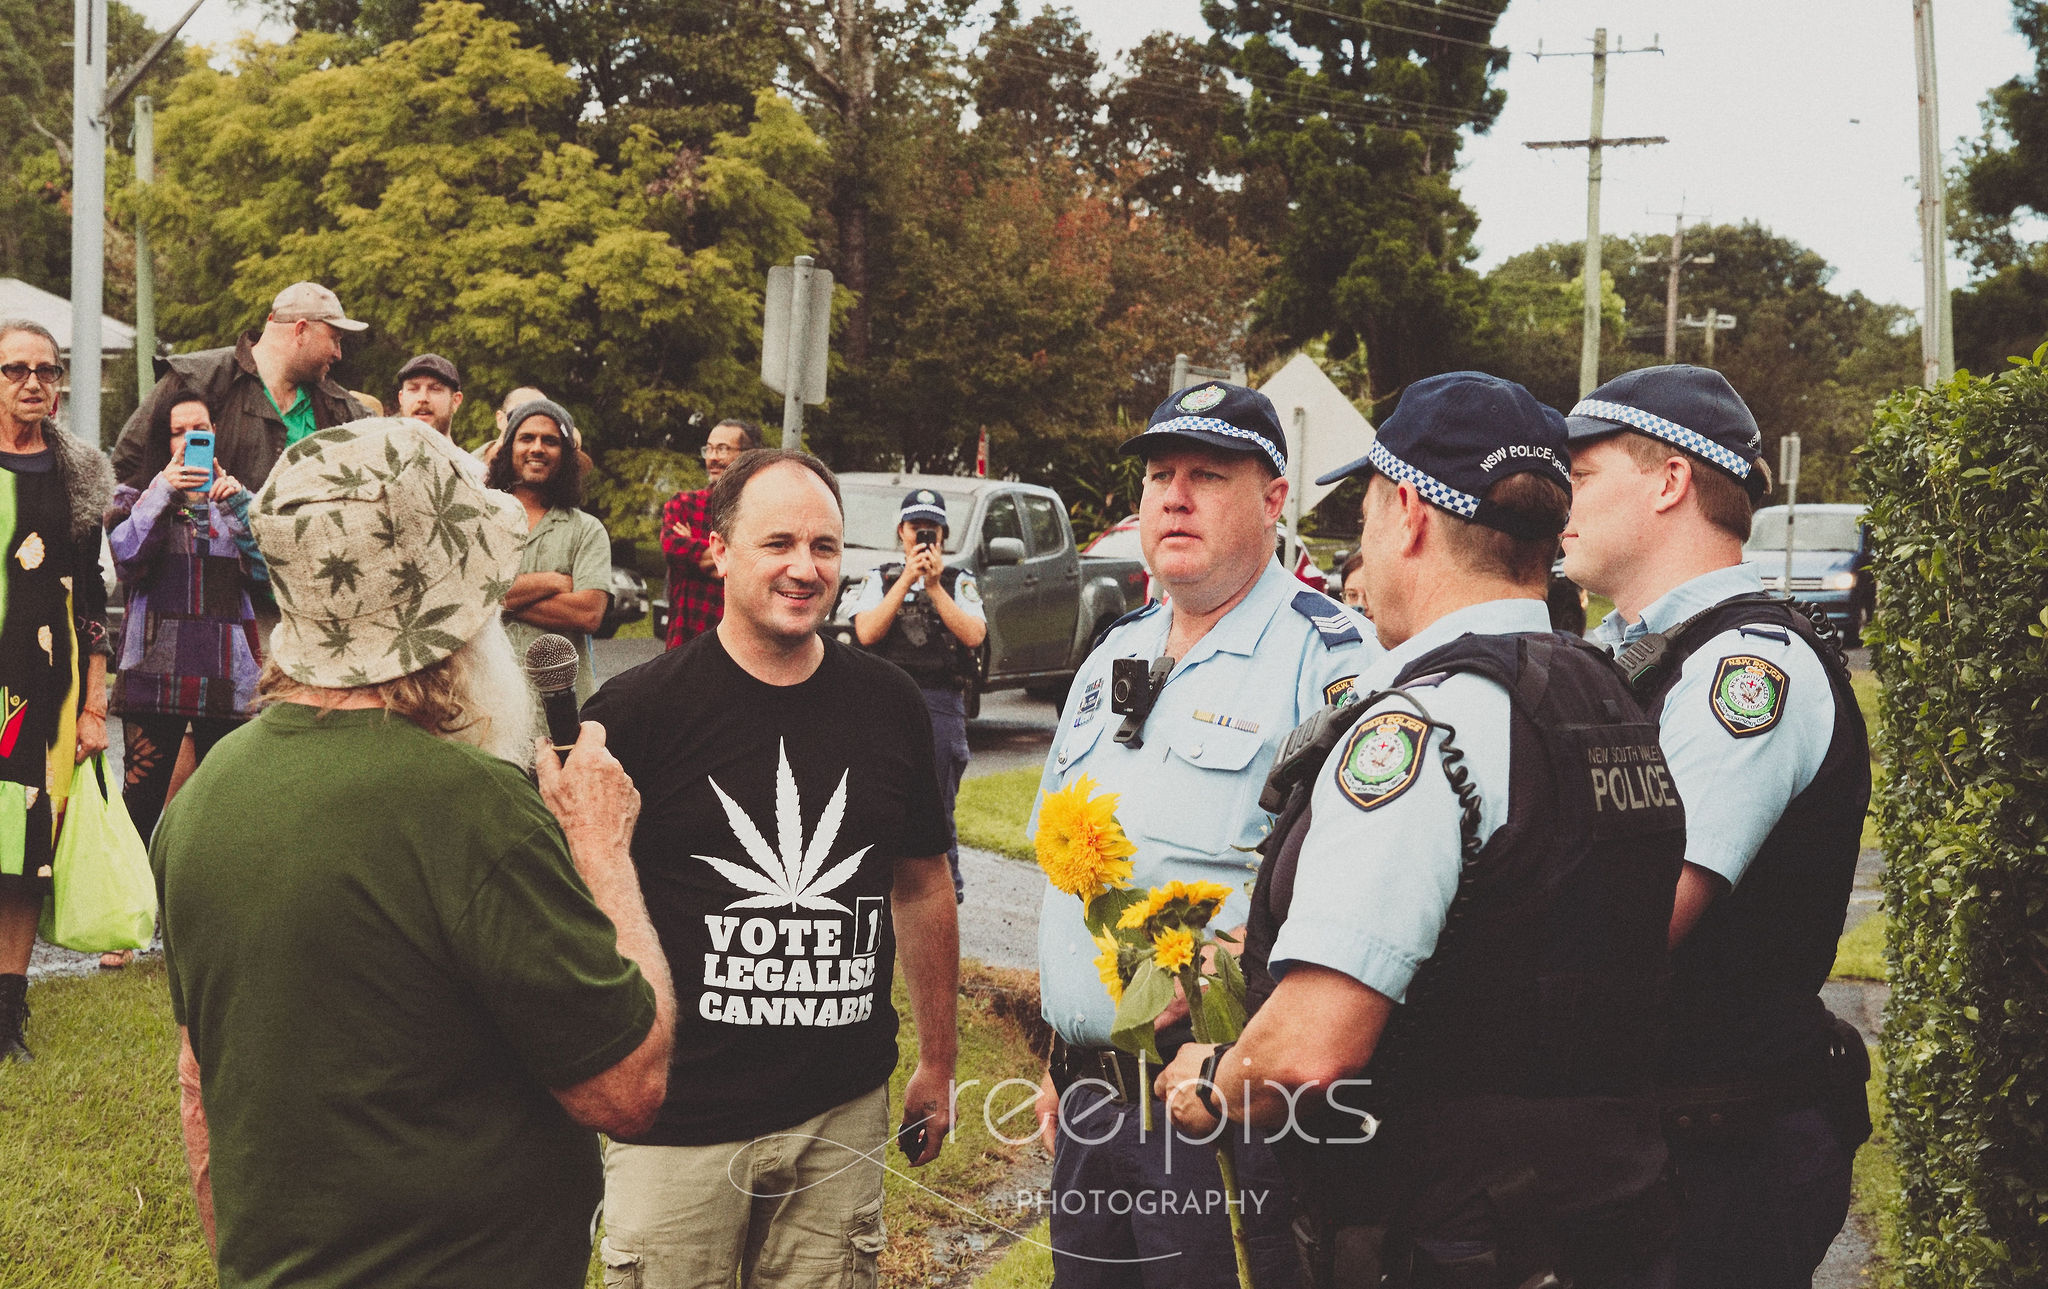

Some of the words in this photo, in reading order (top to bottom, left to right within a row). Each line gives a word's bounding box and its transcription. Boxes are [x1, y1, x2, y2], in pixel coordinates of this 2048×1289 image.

[1480, 447, 1507, 472] NSW
[1509, 445, 1552, 460] POLICE
[1752, 660, 1782, 682] POLICE
[1588, 747, 1608, 764] NEW
[1611, 745, 1639, 763] SOUTH
[1591, 765, 1677, 811] POLICE
[704, 914, 842, 956] VOTE
[703, 953, 876, 992] LEGALISE
[699, 992, 874, 1027] CANNABIS
